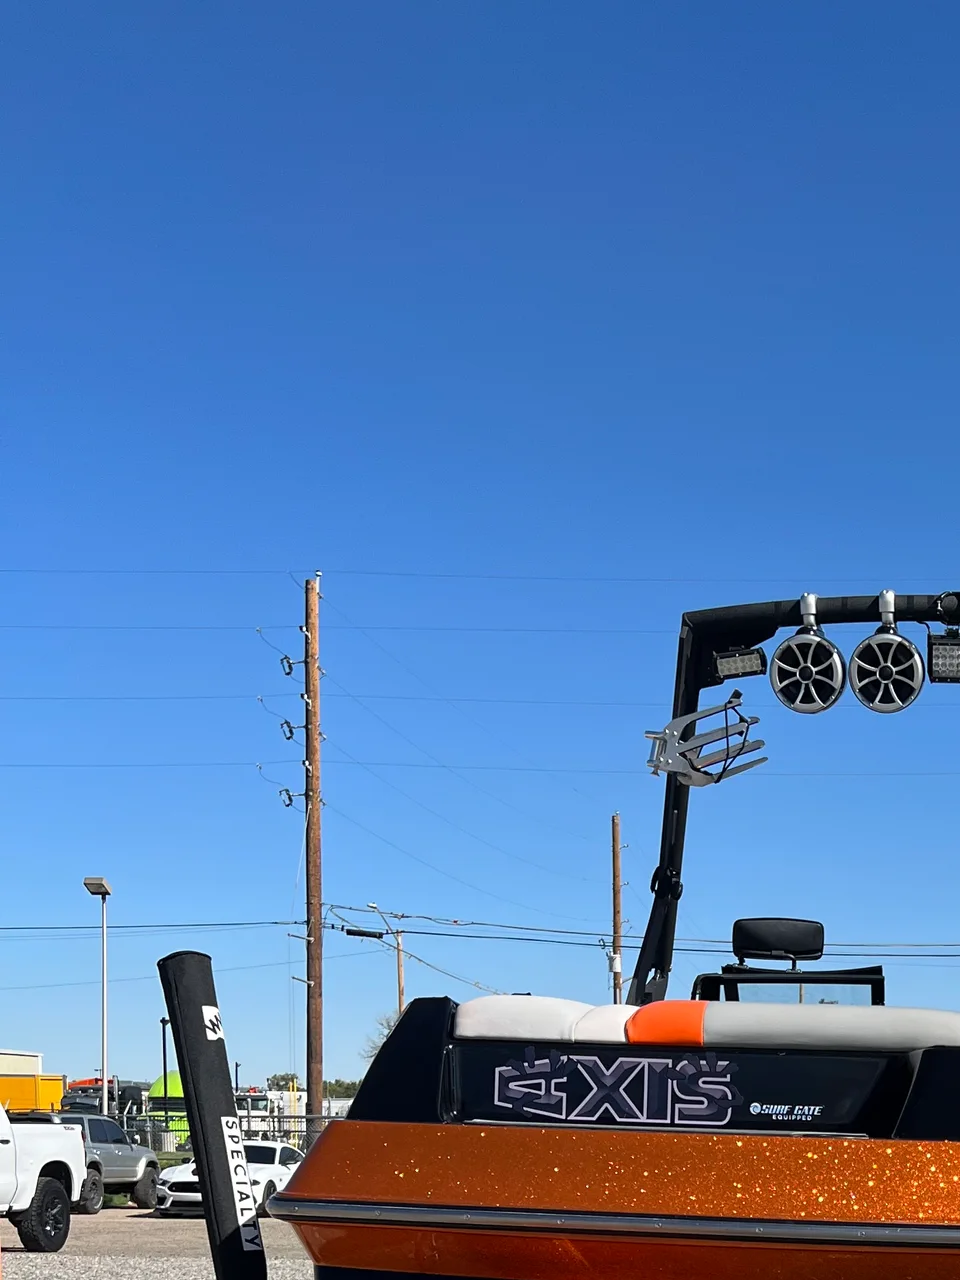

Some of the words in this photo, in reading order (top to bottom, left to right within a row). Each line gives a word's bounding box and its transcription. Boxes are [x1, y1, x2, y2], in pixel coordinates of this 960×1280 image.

[494, 1055, 738, 1125] AXIS
[761, 1105, 792, 1114] SURF
[793, 1105, 823, 1116] GATE
[226, 1120, 262, 1248] SPECIALTY
